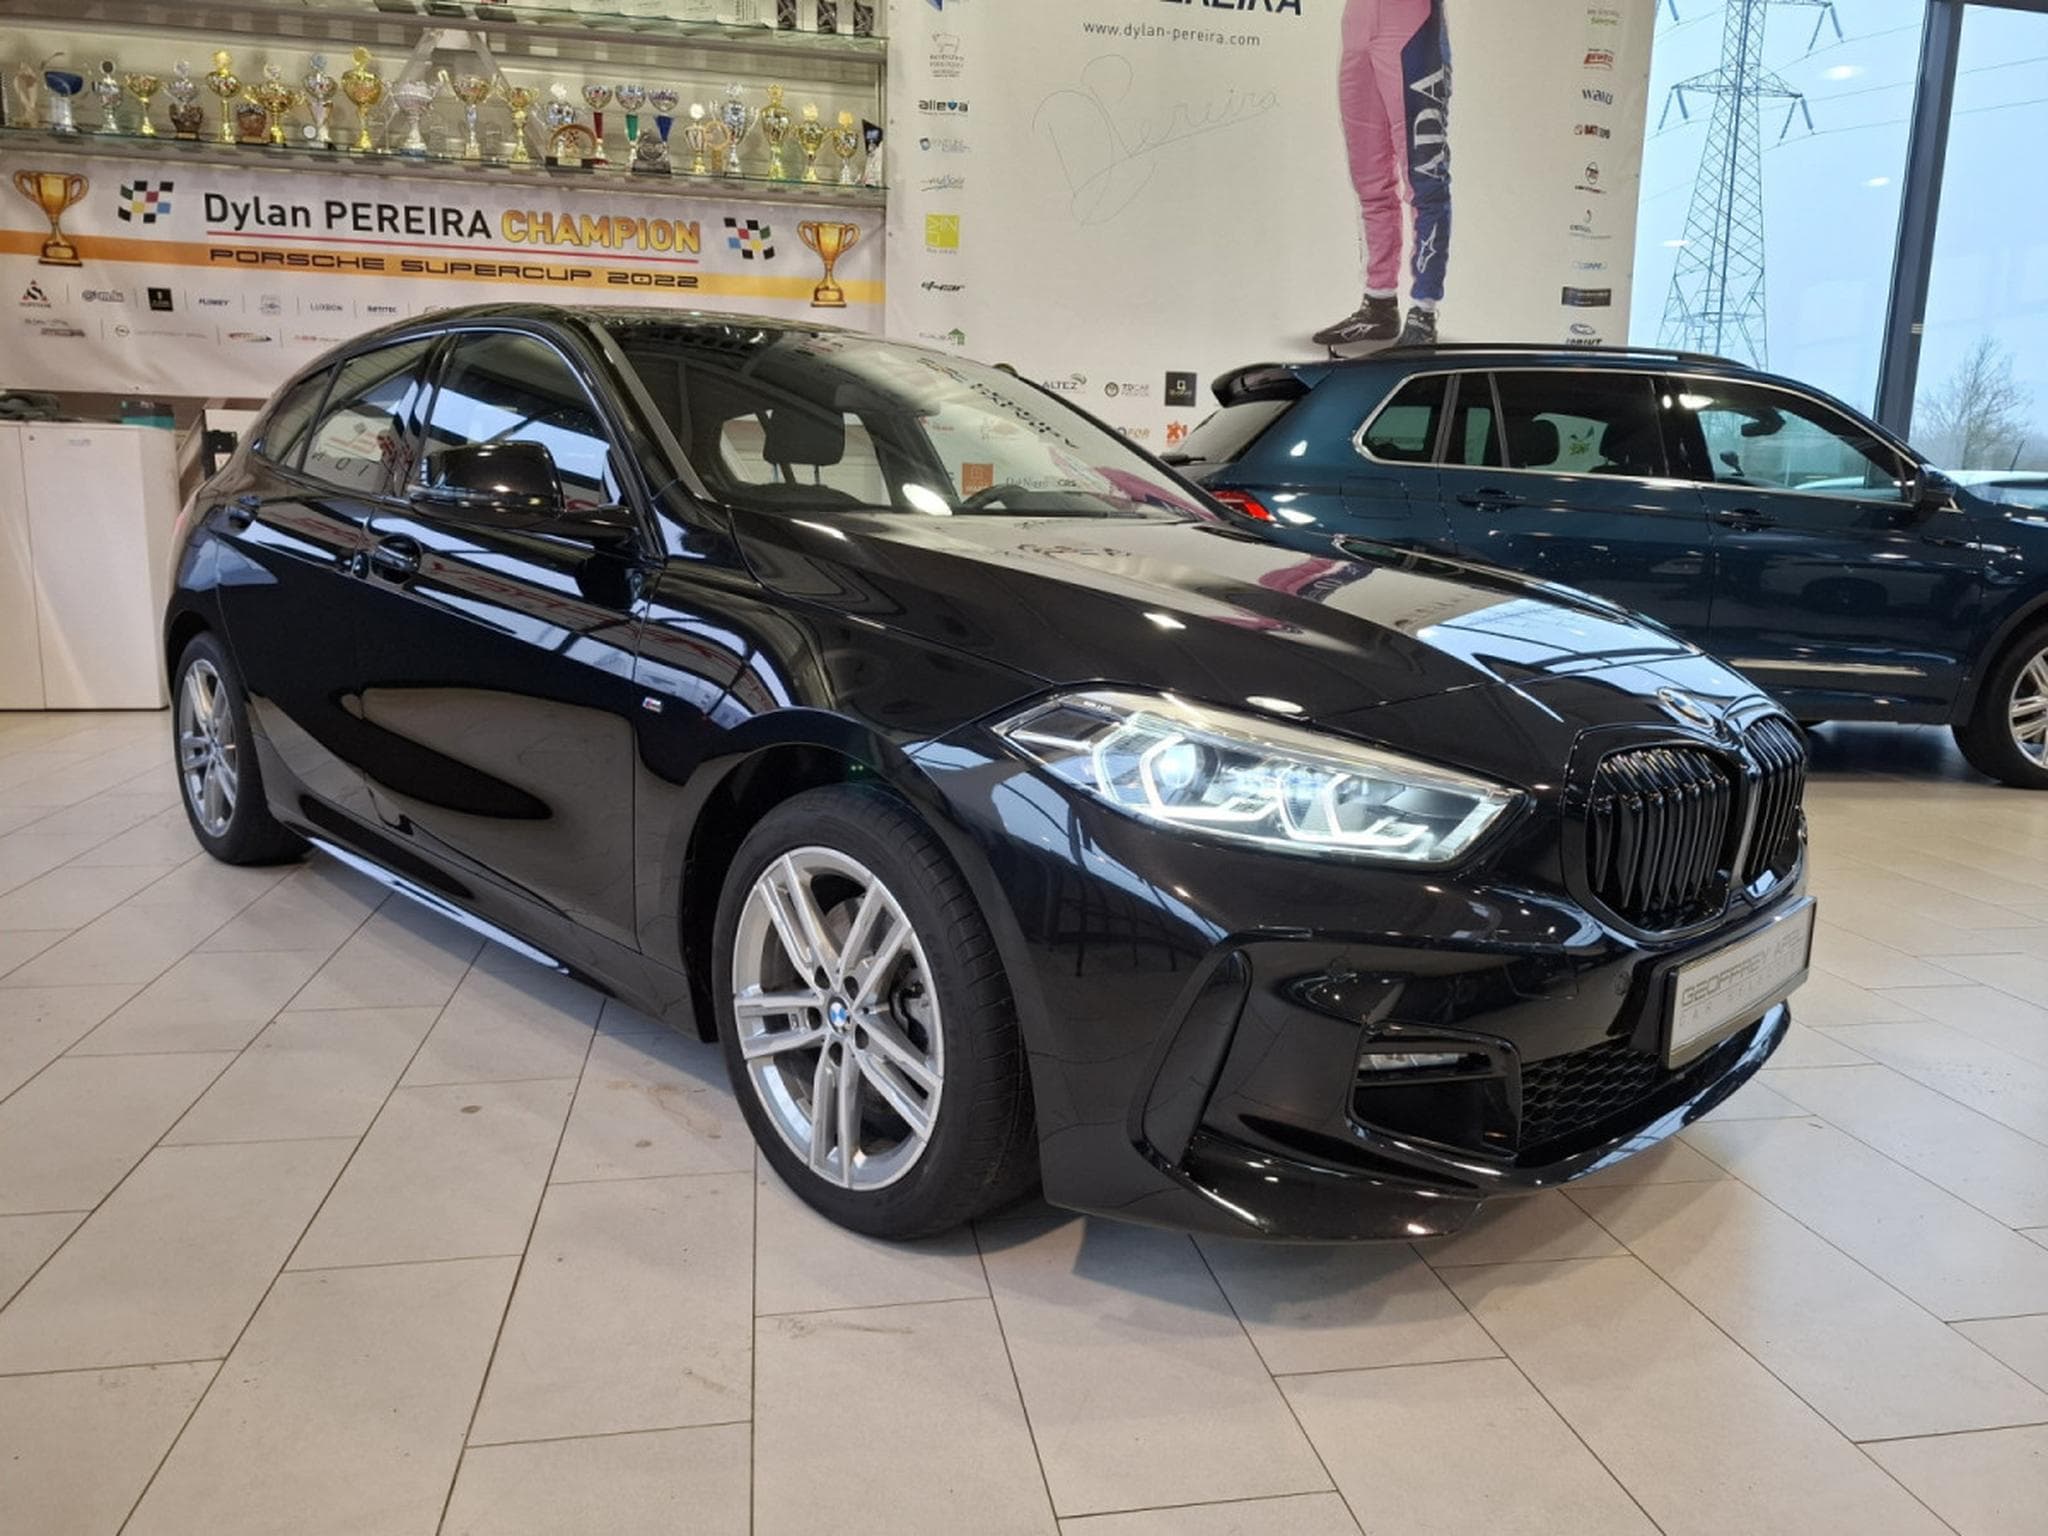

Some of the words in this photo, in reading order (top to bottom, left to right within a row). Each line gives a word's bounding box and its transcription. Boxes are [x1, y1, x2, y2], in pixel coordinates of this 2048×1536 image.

[1083, 21, 1261, 47] www.dylan-pereira.com
[204, 192, 311, 231] Dylan
[325, 201, 492, 239] PEREIRA
[501, 209, 701, 254] CHAMPION
[210, 249, 385, 271] PORSCHE
[401, 260, 592, 281] SUPERCUP
[607, 271, 699, 288] 2022
